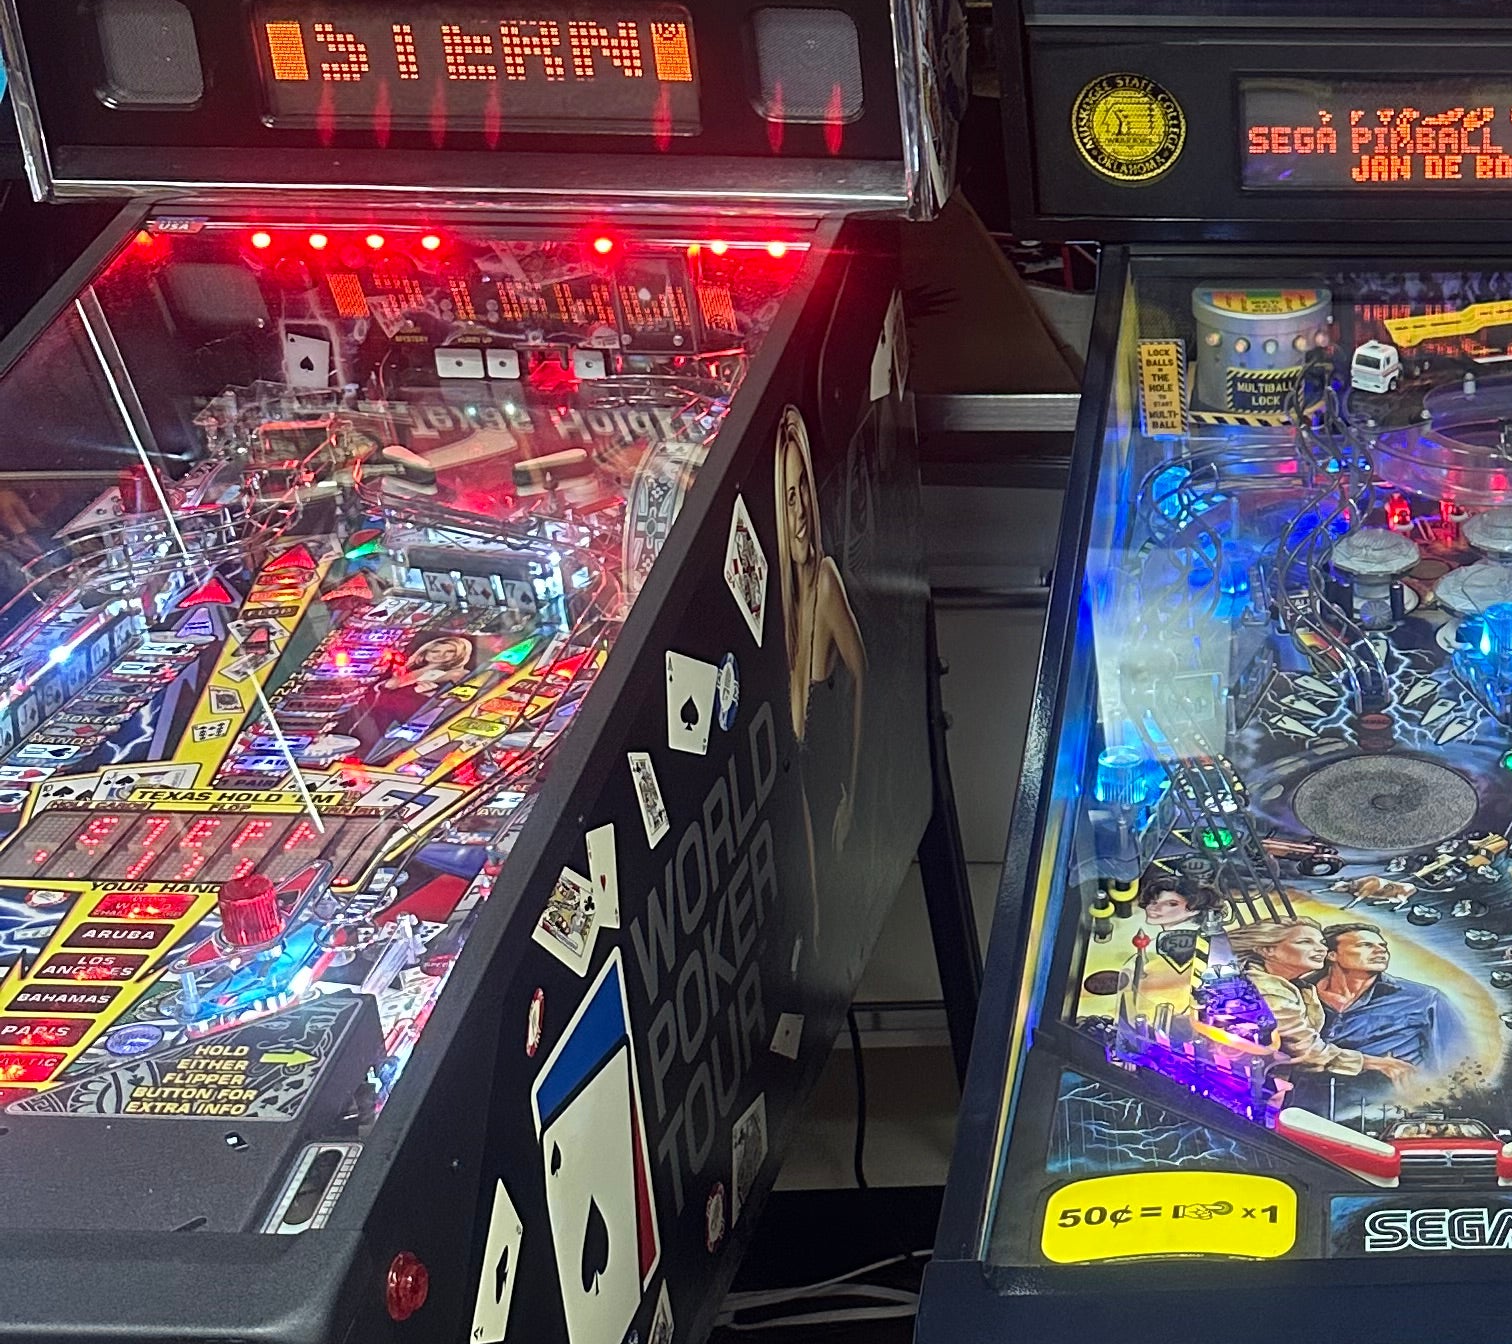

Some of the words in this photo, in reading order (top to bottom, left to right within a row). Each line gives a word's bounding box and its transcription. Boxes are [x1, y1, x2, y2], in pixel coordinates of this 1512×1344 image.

[1115, 76, 1156, 94] STATE
[1248, 126, 1337, 154] SEGA
[1350, 126, 1503, 154] PINBALL
[1098, 155, 1166, 175] OKLAHOMA
[1350, 155, 1411, 182] JAN
[1424, 155, 1463, 180] DE
[158, 222, 190, 231] USA
[1147, 349, 1170, 357] LOCK
[1146, 359, 1174, 367] BALLS
[1151, 374, 1170, 382] THE
[1149, 384, 1174, 393] HOLE
[1236, 381, 1295, 393] MULTIBALL
[1251, 396, 1281, 406] LOCK
[1151, 421, 1177, 430] BALL
[247, 607, 296, 618] FLOP
[232, 779, 275, 787] PAIR
[138, 790, 212, 803] TEXAS
[226, 790, 284, 803] HOLD
[630, 701, 778, 1005] WORLD
[91, 882, 149, 892] YOUR
[82, 928, 155, 940] ARUBA
[77, 956, 116, 965] LOS
[649, 819, 778, 1121] POKER
[16, 993, 111, 1004] BAHAMAS
[1, 1025, 71, 1037] PARIS
[195, 1045, 250, 1056] HOLD
[177, 1059, 249, 1070] EITHER
[162, 1072, 246, 1085] FLIPPER
[132, 1087, 215, 1099] BUTTON
[217, 1088, 258, 1100] FOR
[659, 960, 767, 1216] TOUR
[125, 1102, 193, 1114] EXTRA
[195, 1103, 248, 1115] INFO
